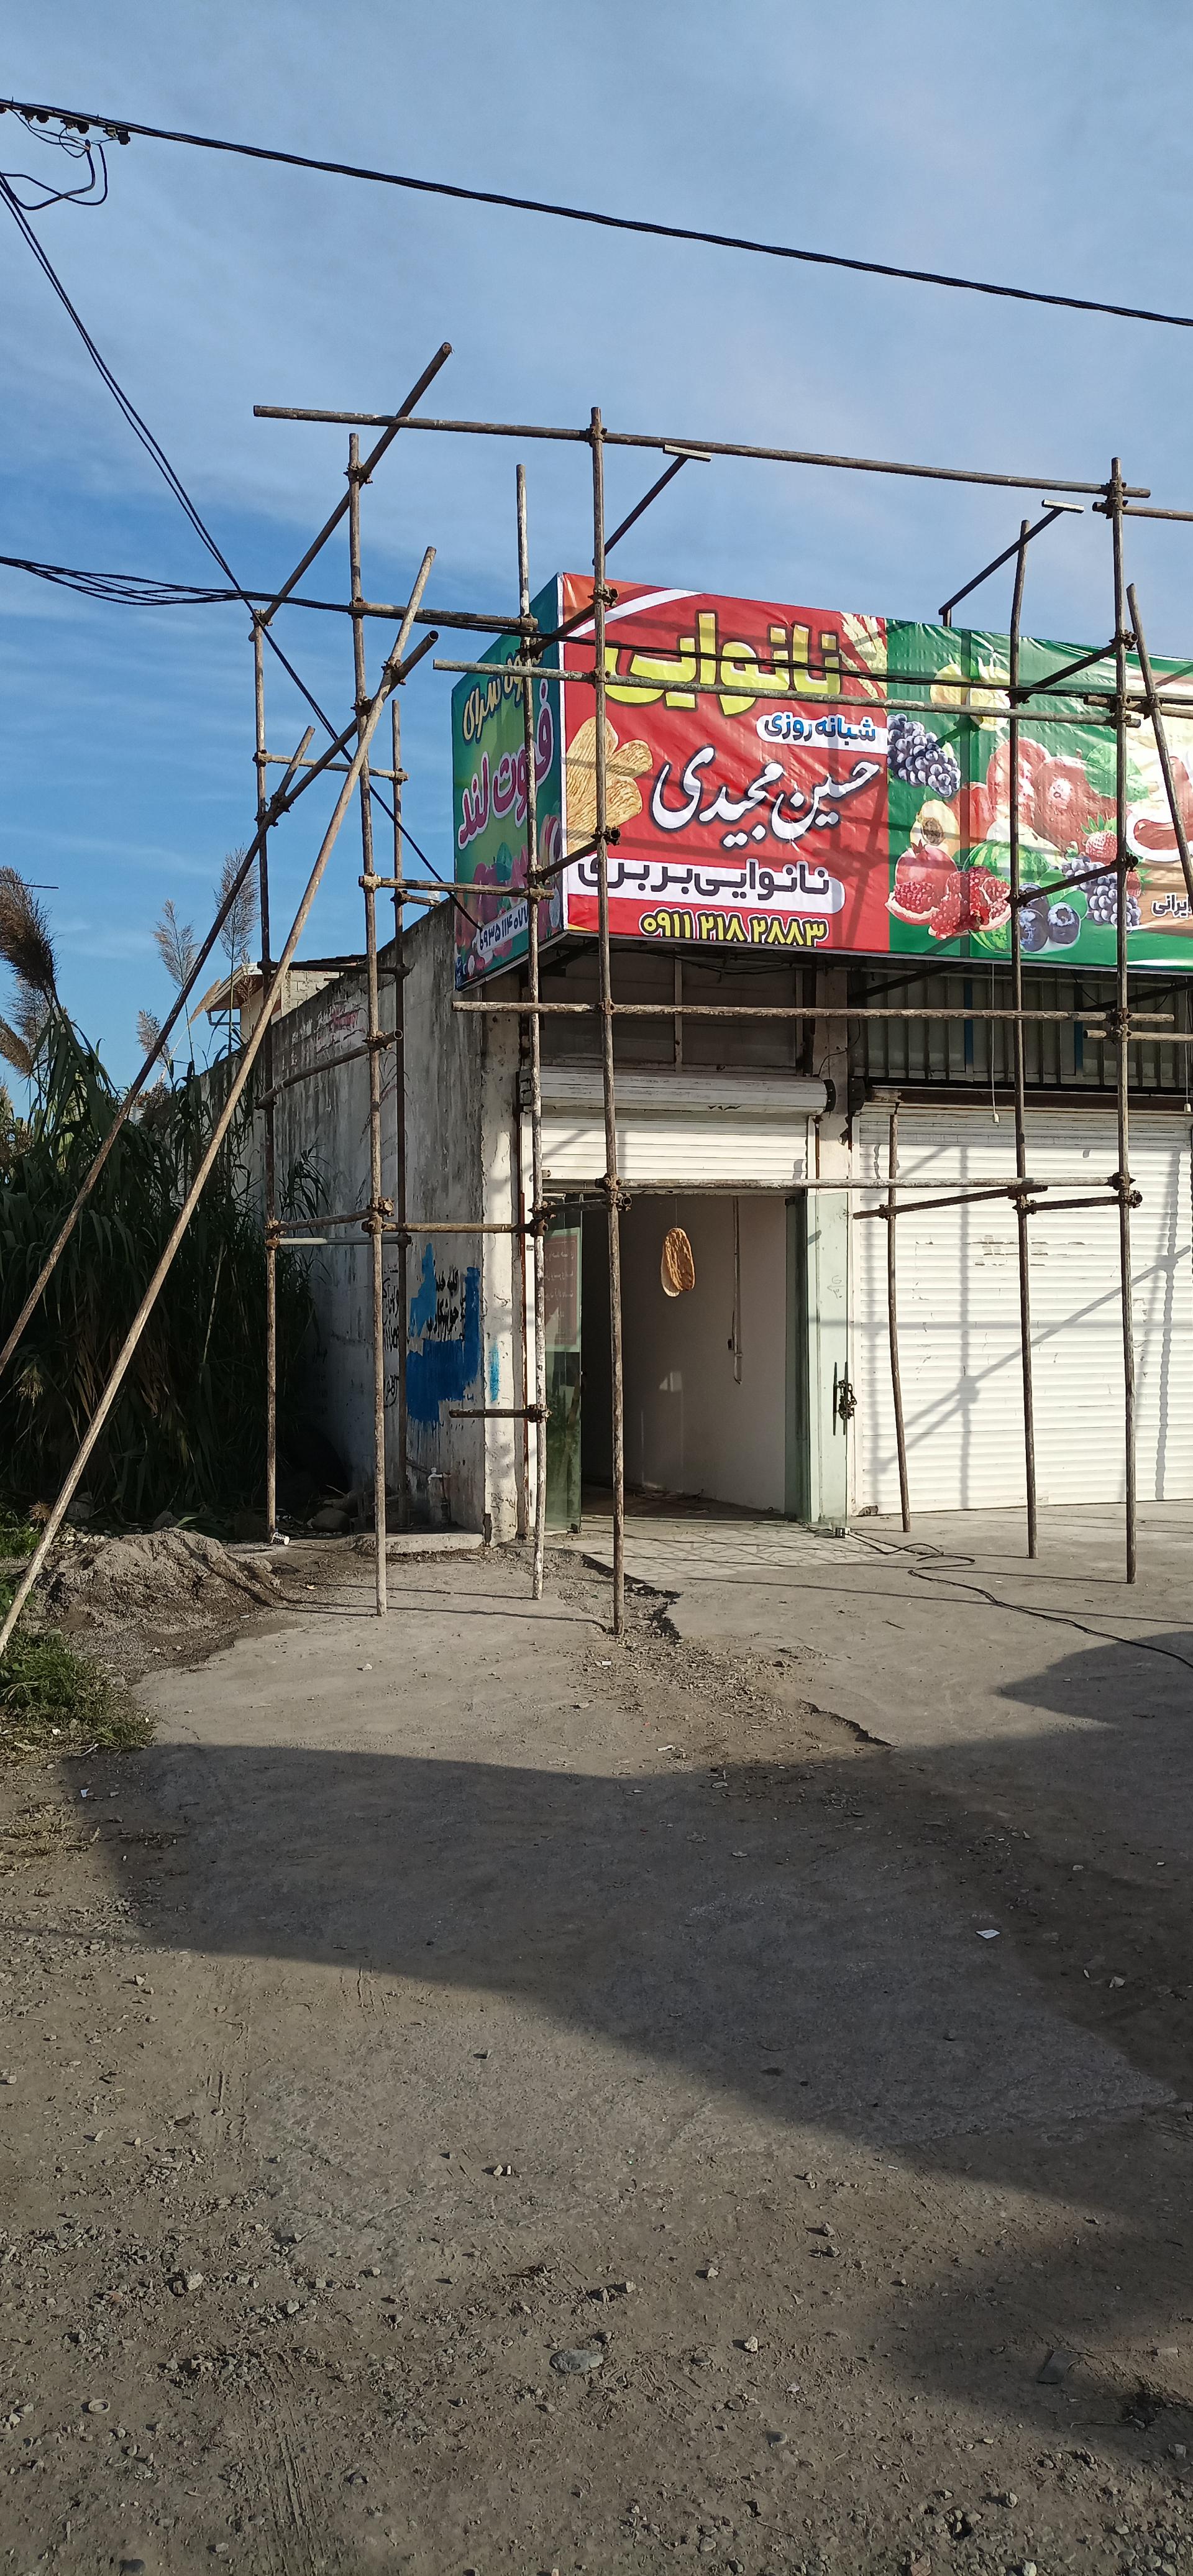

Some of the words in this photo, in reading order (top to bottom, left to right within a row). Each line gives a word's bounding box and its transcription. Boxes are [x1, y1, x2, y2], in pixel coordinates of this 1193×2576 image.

[463, 677, 501, 739] سرای
[764, 714, 813, 742] روزی
[815, 714, 876, 746] شبانه
[493, 682, 554, 822] فوت
[459, 756, 488, 845] لند
[651, 746, 785, 848] مجیدی
[770, 760, 880, 840] حسین
[577, 856, 693, 894] بربری
[693, 861, 830, 901] نانوایی
[642, 911, 692, 939] ۰۹۱۱
[699, 914, 745, 942] ۲۱۸
[752, 919, 826, 947] ۲۸۸۳
